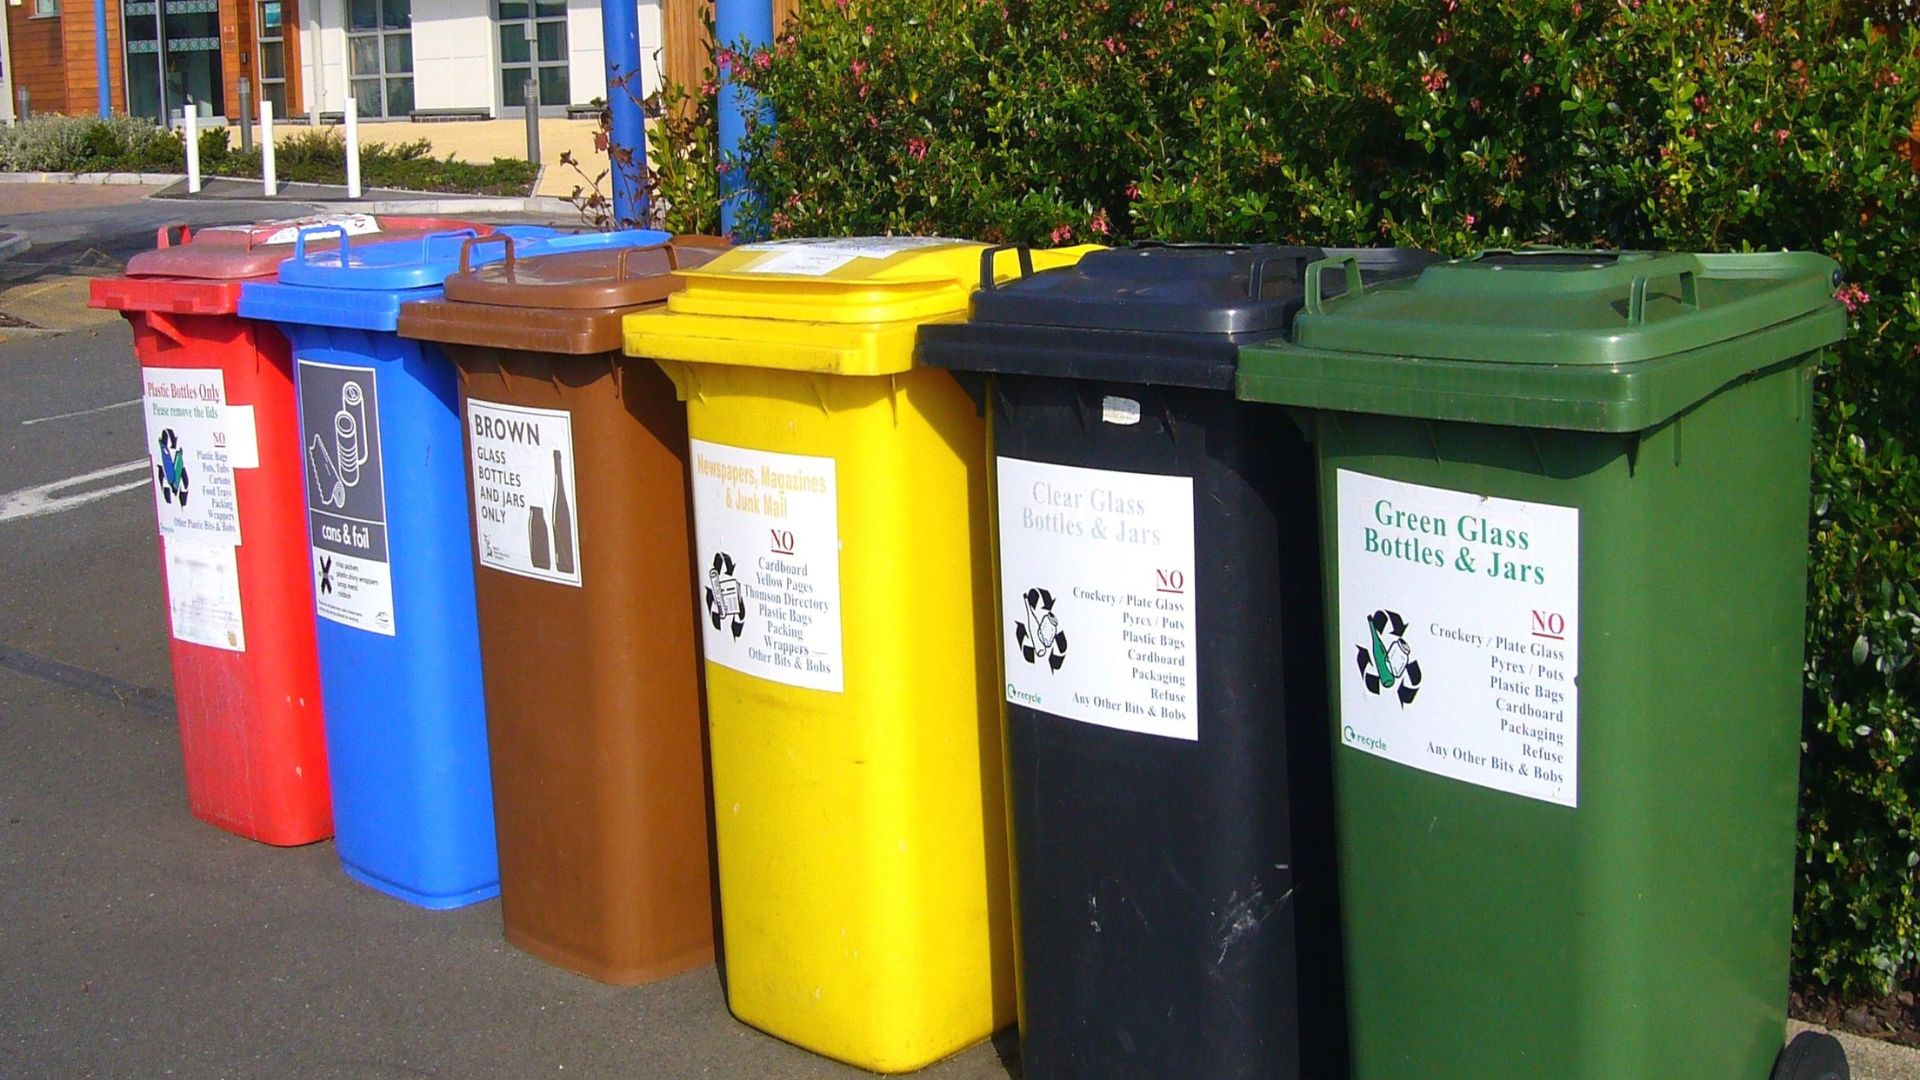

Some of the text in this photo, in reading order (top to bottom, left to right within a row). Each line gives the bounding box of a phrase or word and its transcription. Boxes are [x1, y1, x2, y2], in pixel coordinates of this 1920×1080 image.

[147, 382, 220, 403] Plastic Bottles Only
[213, 432, 226, 445] NO
[474, 414, 540, 446] BROWN
[477, 446, 506, 465] GLASS
[478, 466, 522, 488] BOTTLES
[697, 453, 826, 496] Newspapers, Magazines
[480, 486, 526, 508] AND JARS
[726, 488, 788, 518] & Junk Mail
[1032, 480, 1145, 516] Clear Glass
[482, 506, 506, 524] ONLY
[1022, 506, 1161, 546] Bottles & Jars
[1375, 500, 1529, 550] Green Glass
[322, 523, 370, 549] cans & foil
[770, 529, 794, 552] NO
[758, 556, 808, 577] Cardboard
[1364, 527, 1545, 585] Bottles & Jars
[756, 572, 814, 595] Yellow Pages
[1156, 568, 1184, 590] NO
[744, 584, 830, 614] Thomson Directory
[1072, 586, 1116, 606] Crockery
[1126, 594, 1152, 608] Plate
[1156, 597, 1185, 612] Glass
[759, 604, 812, 626] Plastic Bags
[1122, 612, 1152, 628] Pyrex
[1162, 616, 1185, 630] Pots
[1532, 610, 1565, 636] NO
[767, 620, 804, 641] Packing
[1122, 630, 1185, 650] Plastic Bags
[1430, 622, 1484, 648] Crockery
[1495, 636, 1526, 655] Plate
[1530, 642, 1565, 661] Glass
[764, 635, 810, 657] Wrappers
[1128, 648, 1186, 667] Cardboard
[748, 647, 831, 674] Other Bits & Bobs
[1490, 656, 1525, 674] Pyrex
[1538, 664, 1564, 682] Pots
[1132, 667, 1186, 688] Packaging
[1017, 690, 1042, 704] recycle
[1150, 688, 1186, 702] Refuse
[1490, 676, 1564, 703] Plastic Bags
[1072, 692, 1186, 720] Any Other Bits & Bobs
[1496, 697, 1564, 724] Cardboard
[1356, 733, 1387, 751] recycle
[1500, 718, 1564, 746] Packaging
[1426, 742, 1564, 785] Any Other Bits & Bobs
[1522, 744, 1564, 764] Refuse
